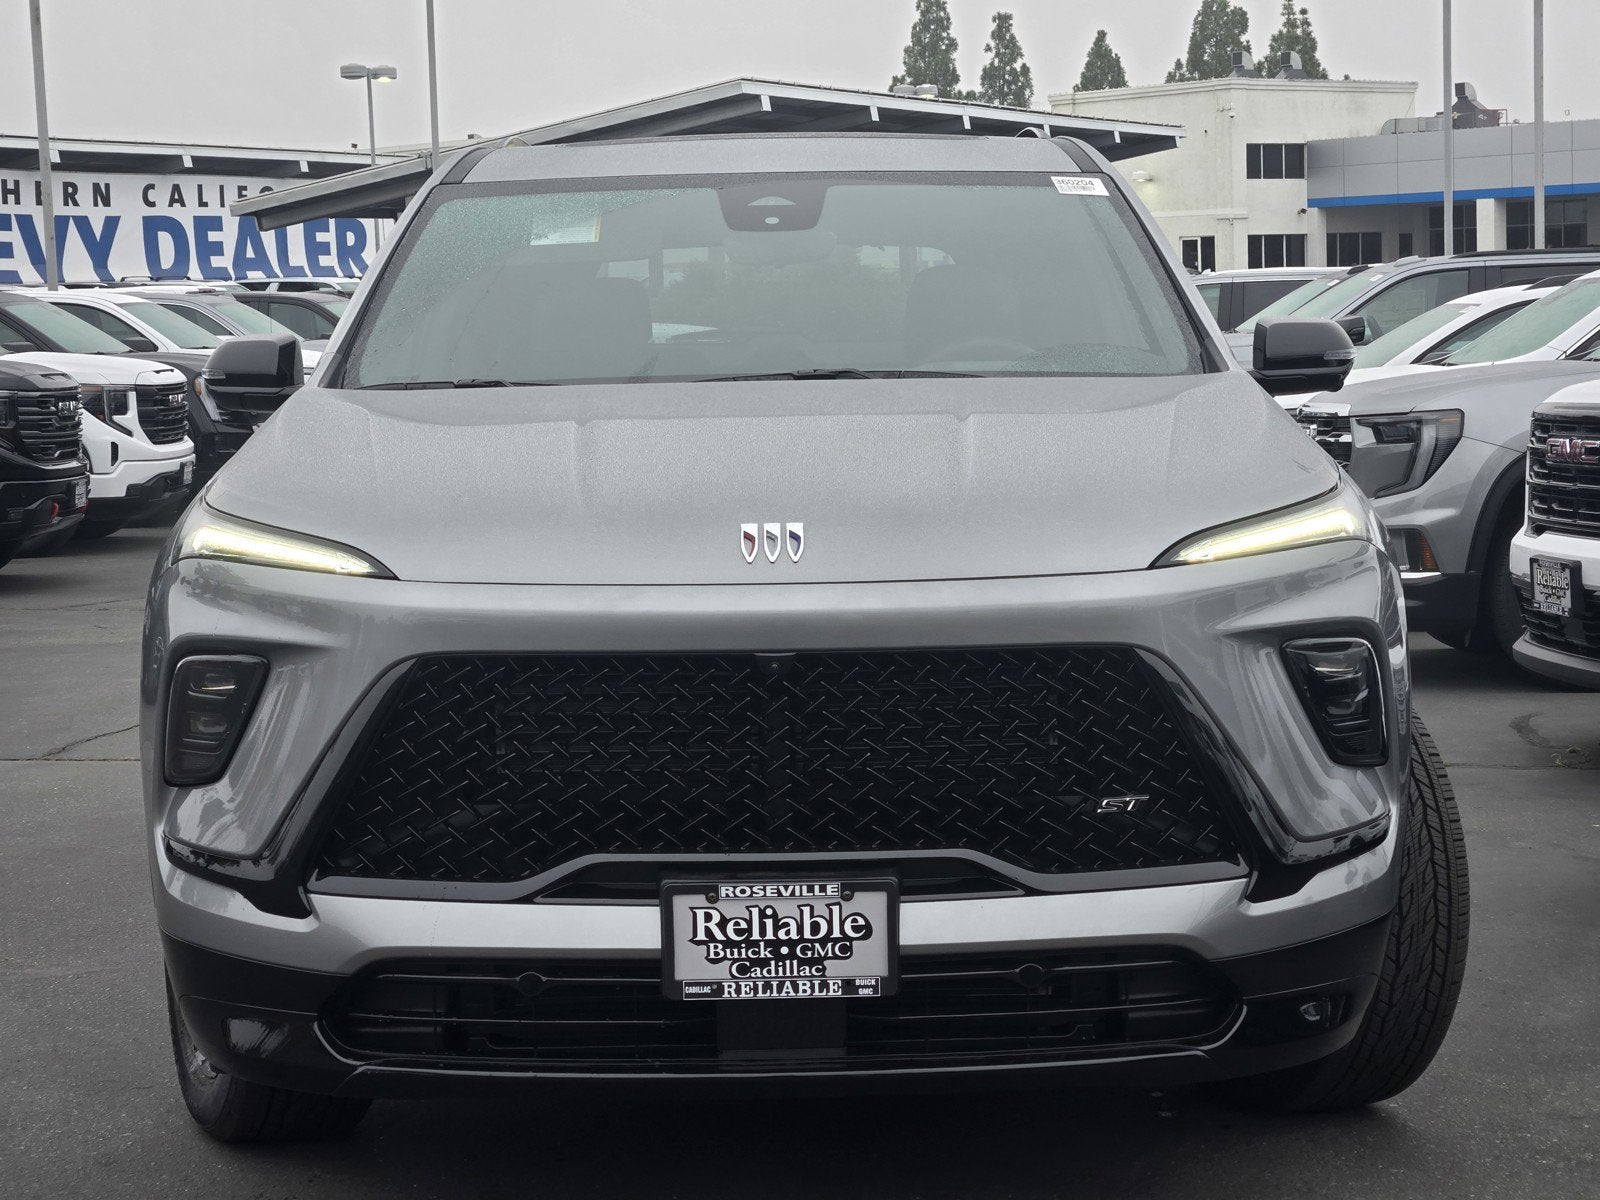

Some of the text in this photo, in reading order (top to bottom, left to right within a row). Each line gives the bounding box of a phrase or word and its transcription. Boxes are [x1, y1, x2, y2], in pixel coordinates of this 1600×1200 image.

[1545, 437, 1600, 463] GMC
[1536, 569, 1569, 588] Reliable
[1097, 795, 1149, 813] ST
[720, 884, 839, 898] ROSEVILLE
[692, 904, 867, 942] Reliable
[708, 941, 851, 959] Buick GMC
[730, 960, 824, 978] Cadillac
[685, 979, 842, 998] CADILLAC RELIABLE
[855, 978, 877, 986] BUICK
[858, 987, 874, 995] GMC
